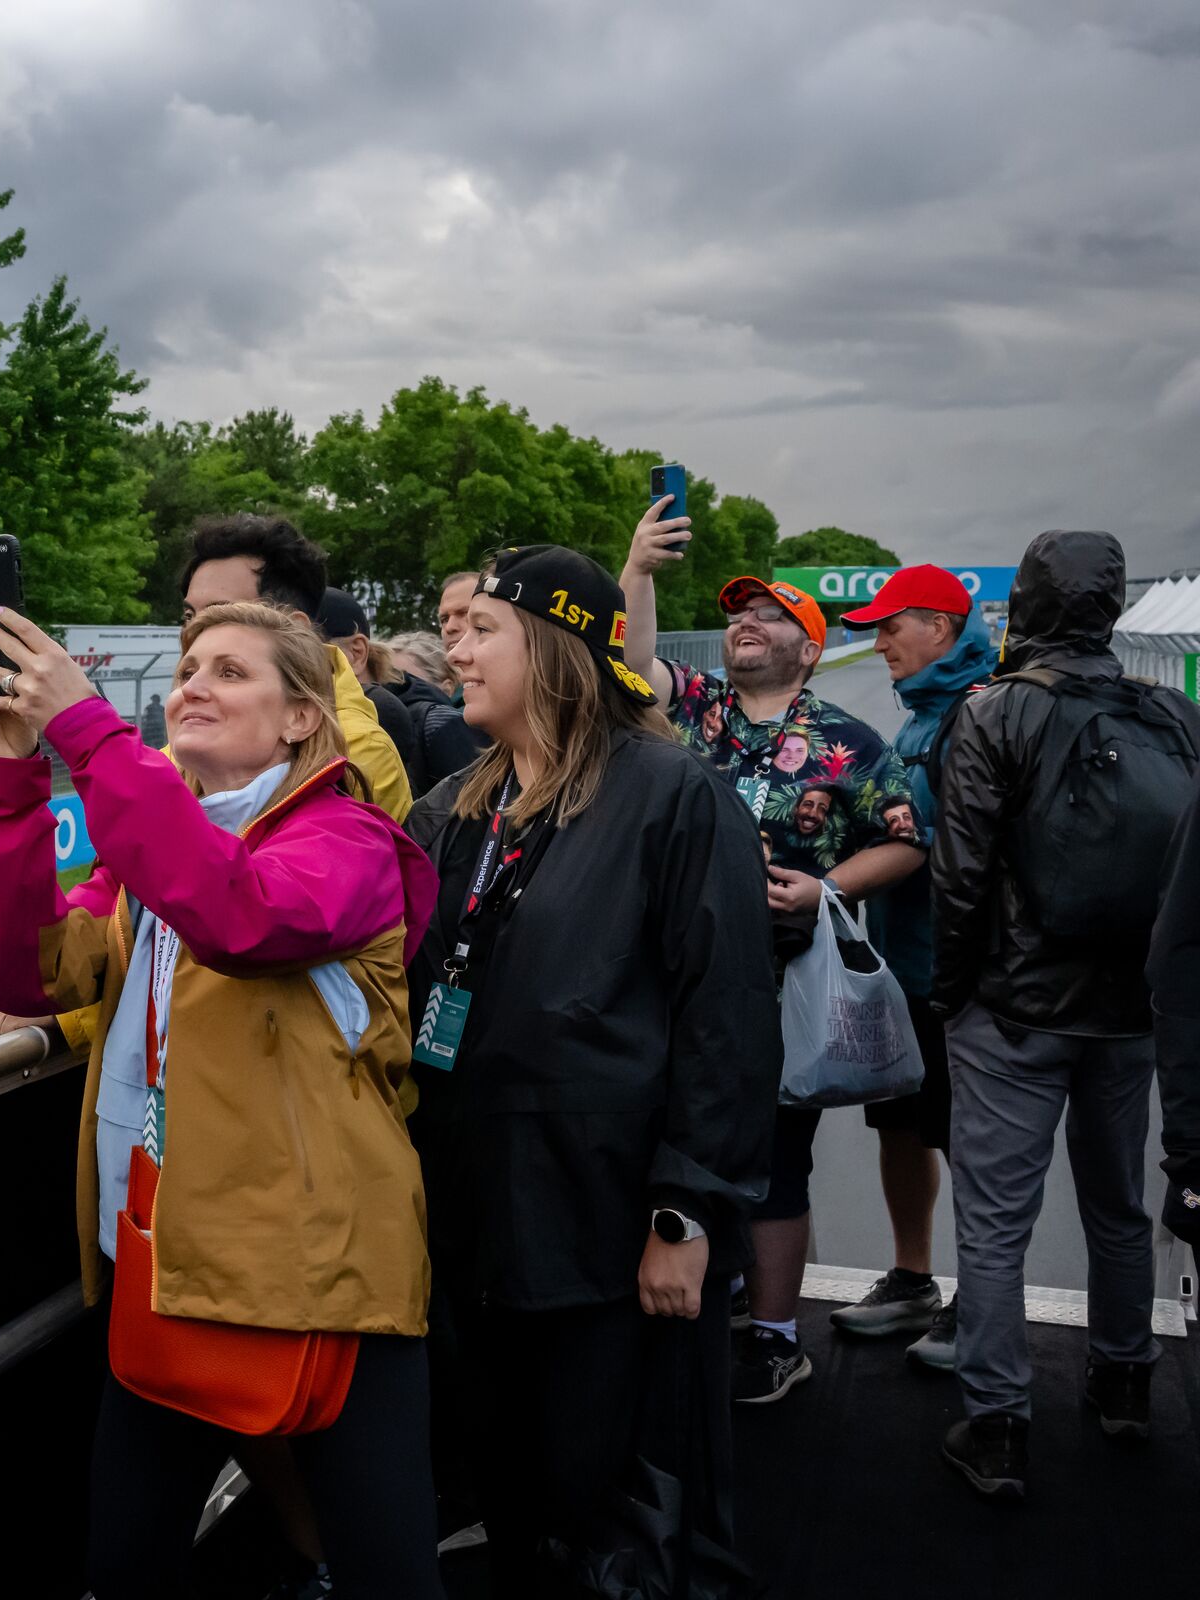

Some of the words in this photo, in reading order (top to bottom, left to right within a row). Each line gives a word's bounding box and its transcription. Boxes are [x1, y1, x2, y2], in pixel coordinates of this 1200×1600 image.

[819, 571, 981, 597] arao
[549, 589, 595, 631] 1ST
[473, 840, 495, 893] Experiences
